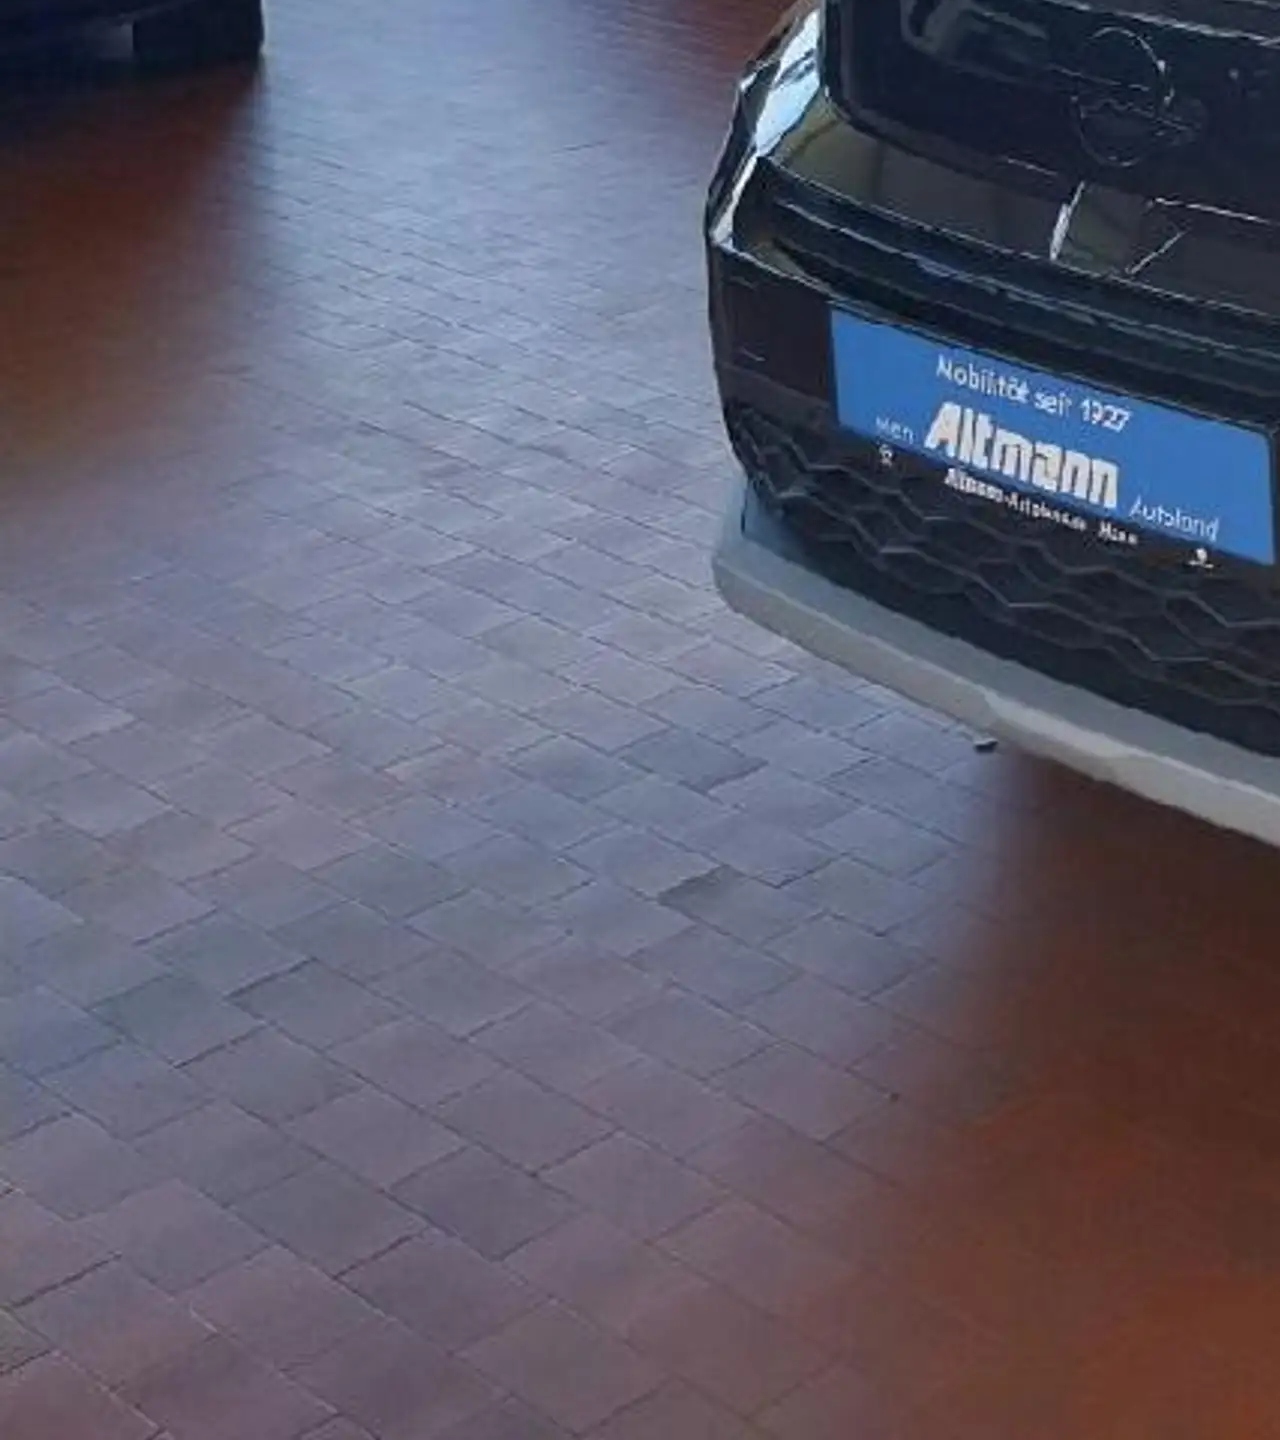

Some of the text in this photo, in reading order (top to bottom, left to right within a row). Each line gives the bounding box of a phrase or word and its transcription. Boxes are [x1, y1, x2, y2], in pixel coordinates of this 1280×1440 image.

[1033, 386, 1073, 418] seit
[1080, 398, 1131, 433] 1927
[923, 400, 1119, 509] Altmann
[1128, 494, 1220, 543] Autoland
